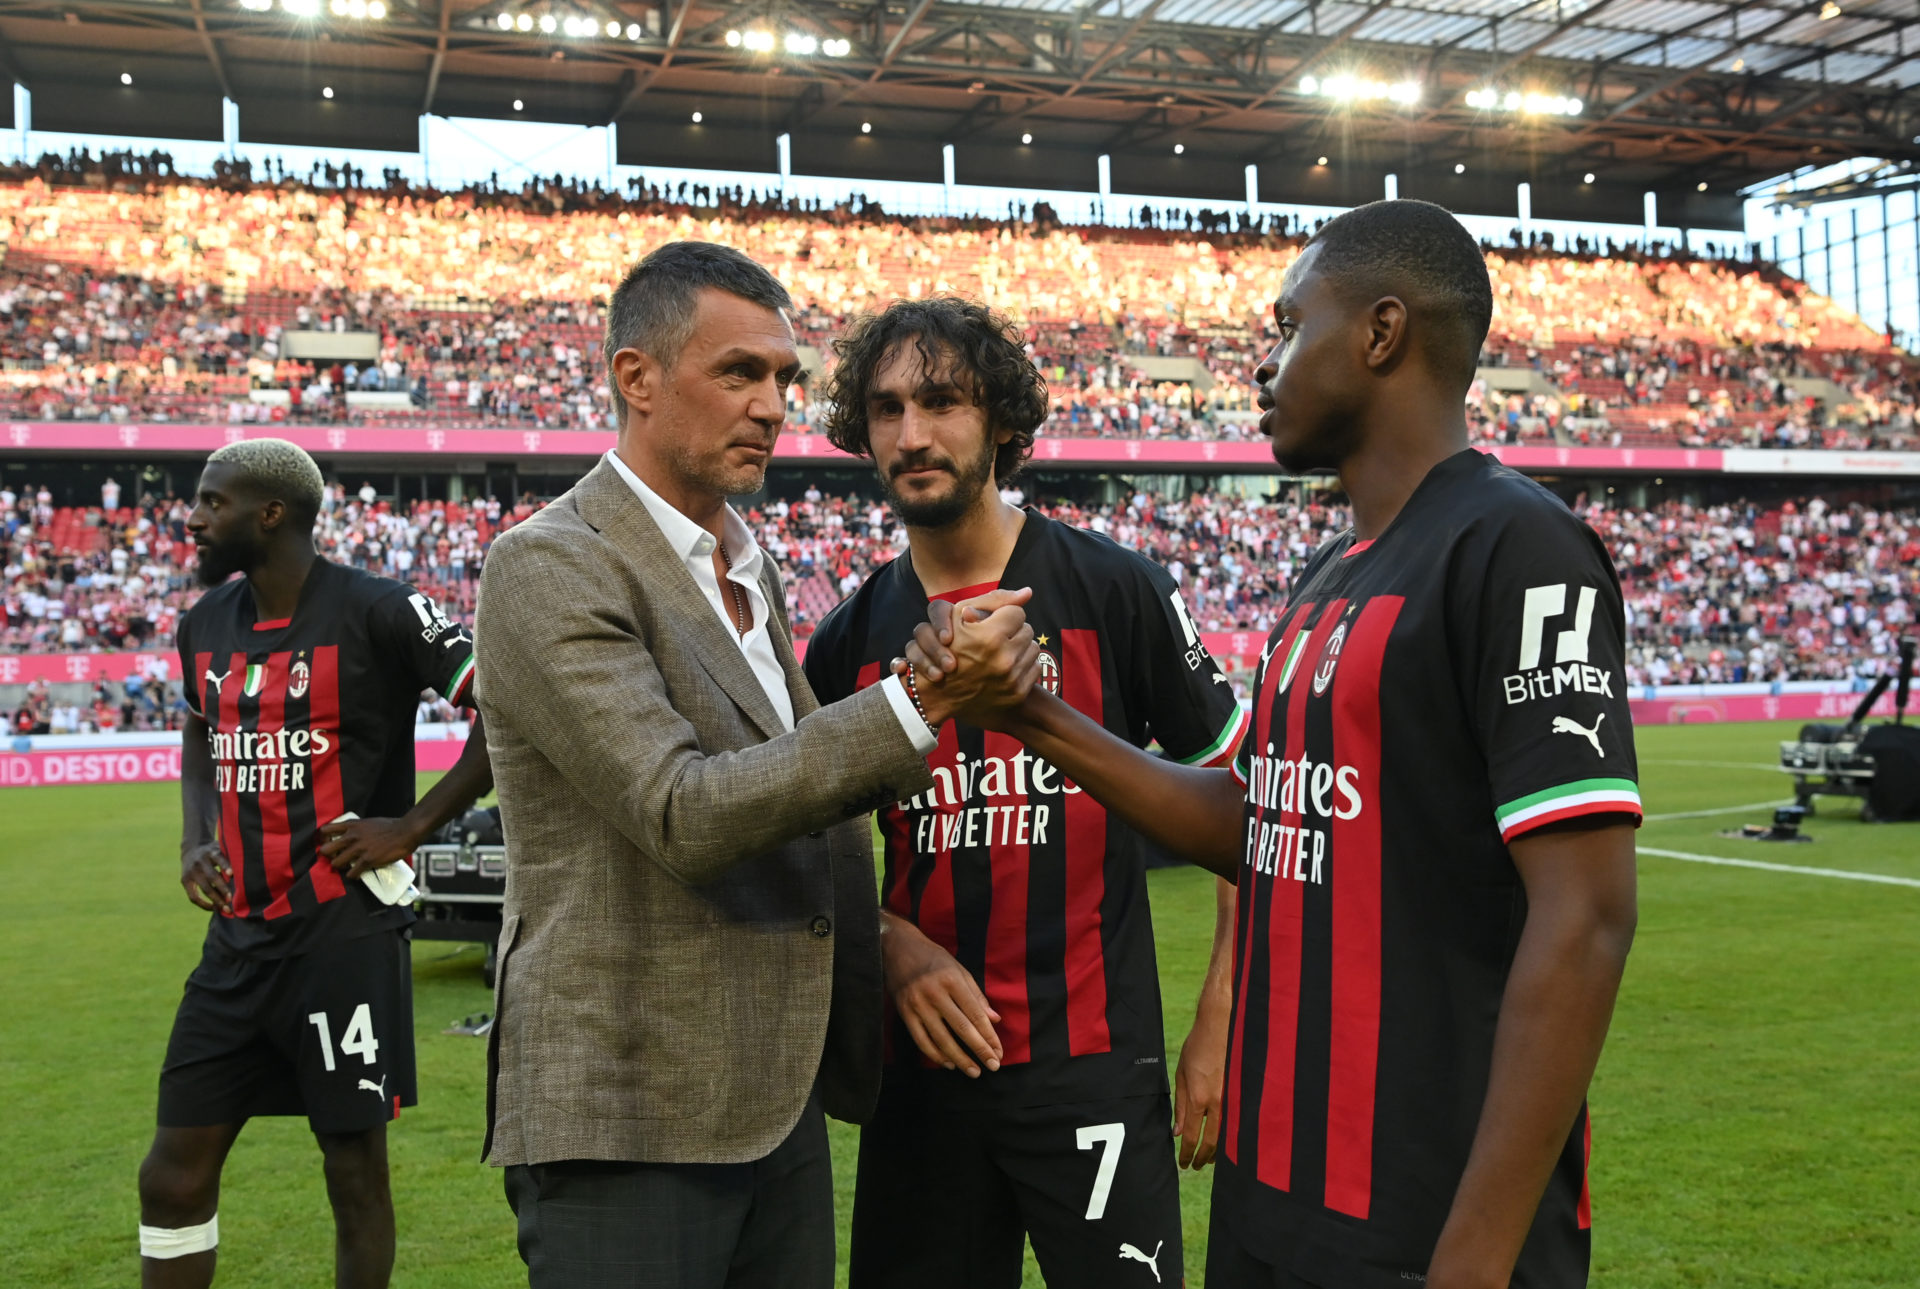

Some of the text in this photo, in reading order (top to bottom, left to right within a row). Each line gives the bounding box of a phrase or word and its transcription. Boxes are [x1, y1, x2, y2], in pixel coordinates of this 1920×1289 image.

[1232, 633, 1249, 653] T
[66, 656, 90, 680] T
[1503, 663, 1614, 705] BitMEX
[43, 753, 142, 783] DESTO
[236, 762, 305, 792] BETTER
[1244, 742, 1362, 820] mirates
[917, 804, 1050, 853] FLY BETTER
[1255, 821, 1325, 884] BETTER
[308, 1003, 379, 1071] 14
[1076, 1122, 1126, 1220] 7
